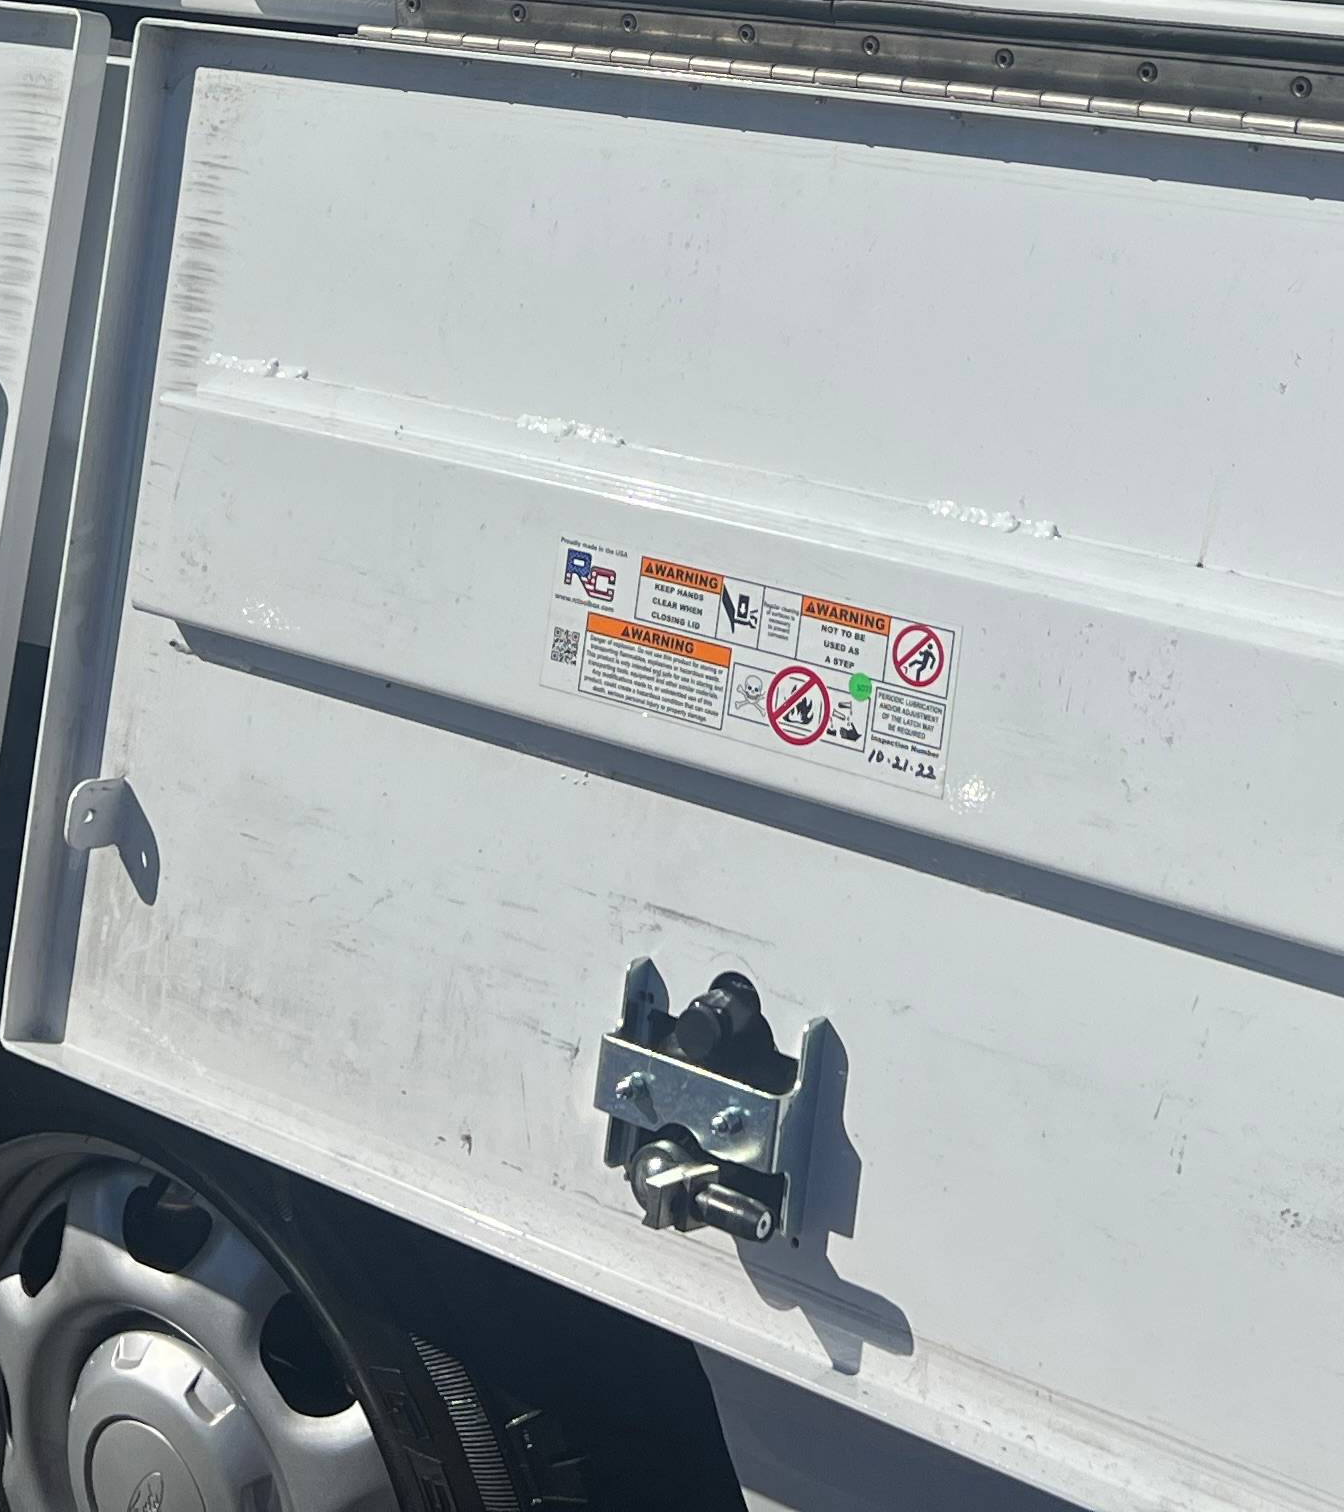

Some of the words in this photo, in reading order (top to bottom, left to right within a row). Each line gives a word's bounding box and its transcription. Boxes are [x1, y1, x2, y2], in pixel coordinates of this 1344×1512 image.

[616, 550, 628, 558] USA
[654, 562, 718, 590] WARNING
[654, 582, 675, 594] KEEP
[676, 588, 704, 601] HANDS
[652, 596, 677, 609] CLEAR
[678, 603, 703, 616] WHEN
[815, 601, 885, 631] WARNING
[651, 610, 685, 626] CLOSING
[687, 619, 700, 630] LID
[631, 626, 694, 654] WARNING
[820, 623, 838, 635] NOT
[840, 628, 851, 638] TO
[854, 632, 865, 642] BE
[823, 639, 846, 652] USED
[848, 645, 859, 655] AS
[824, 655, 830, 663] A
[833, 657, 854, 669] STEP
[870, 733, 909, 751] Inspection
[910, 745, 939, 758] Number
